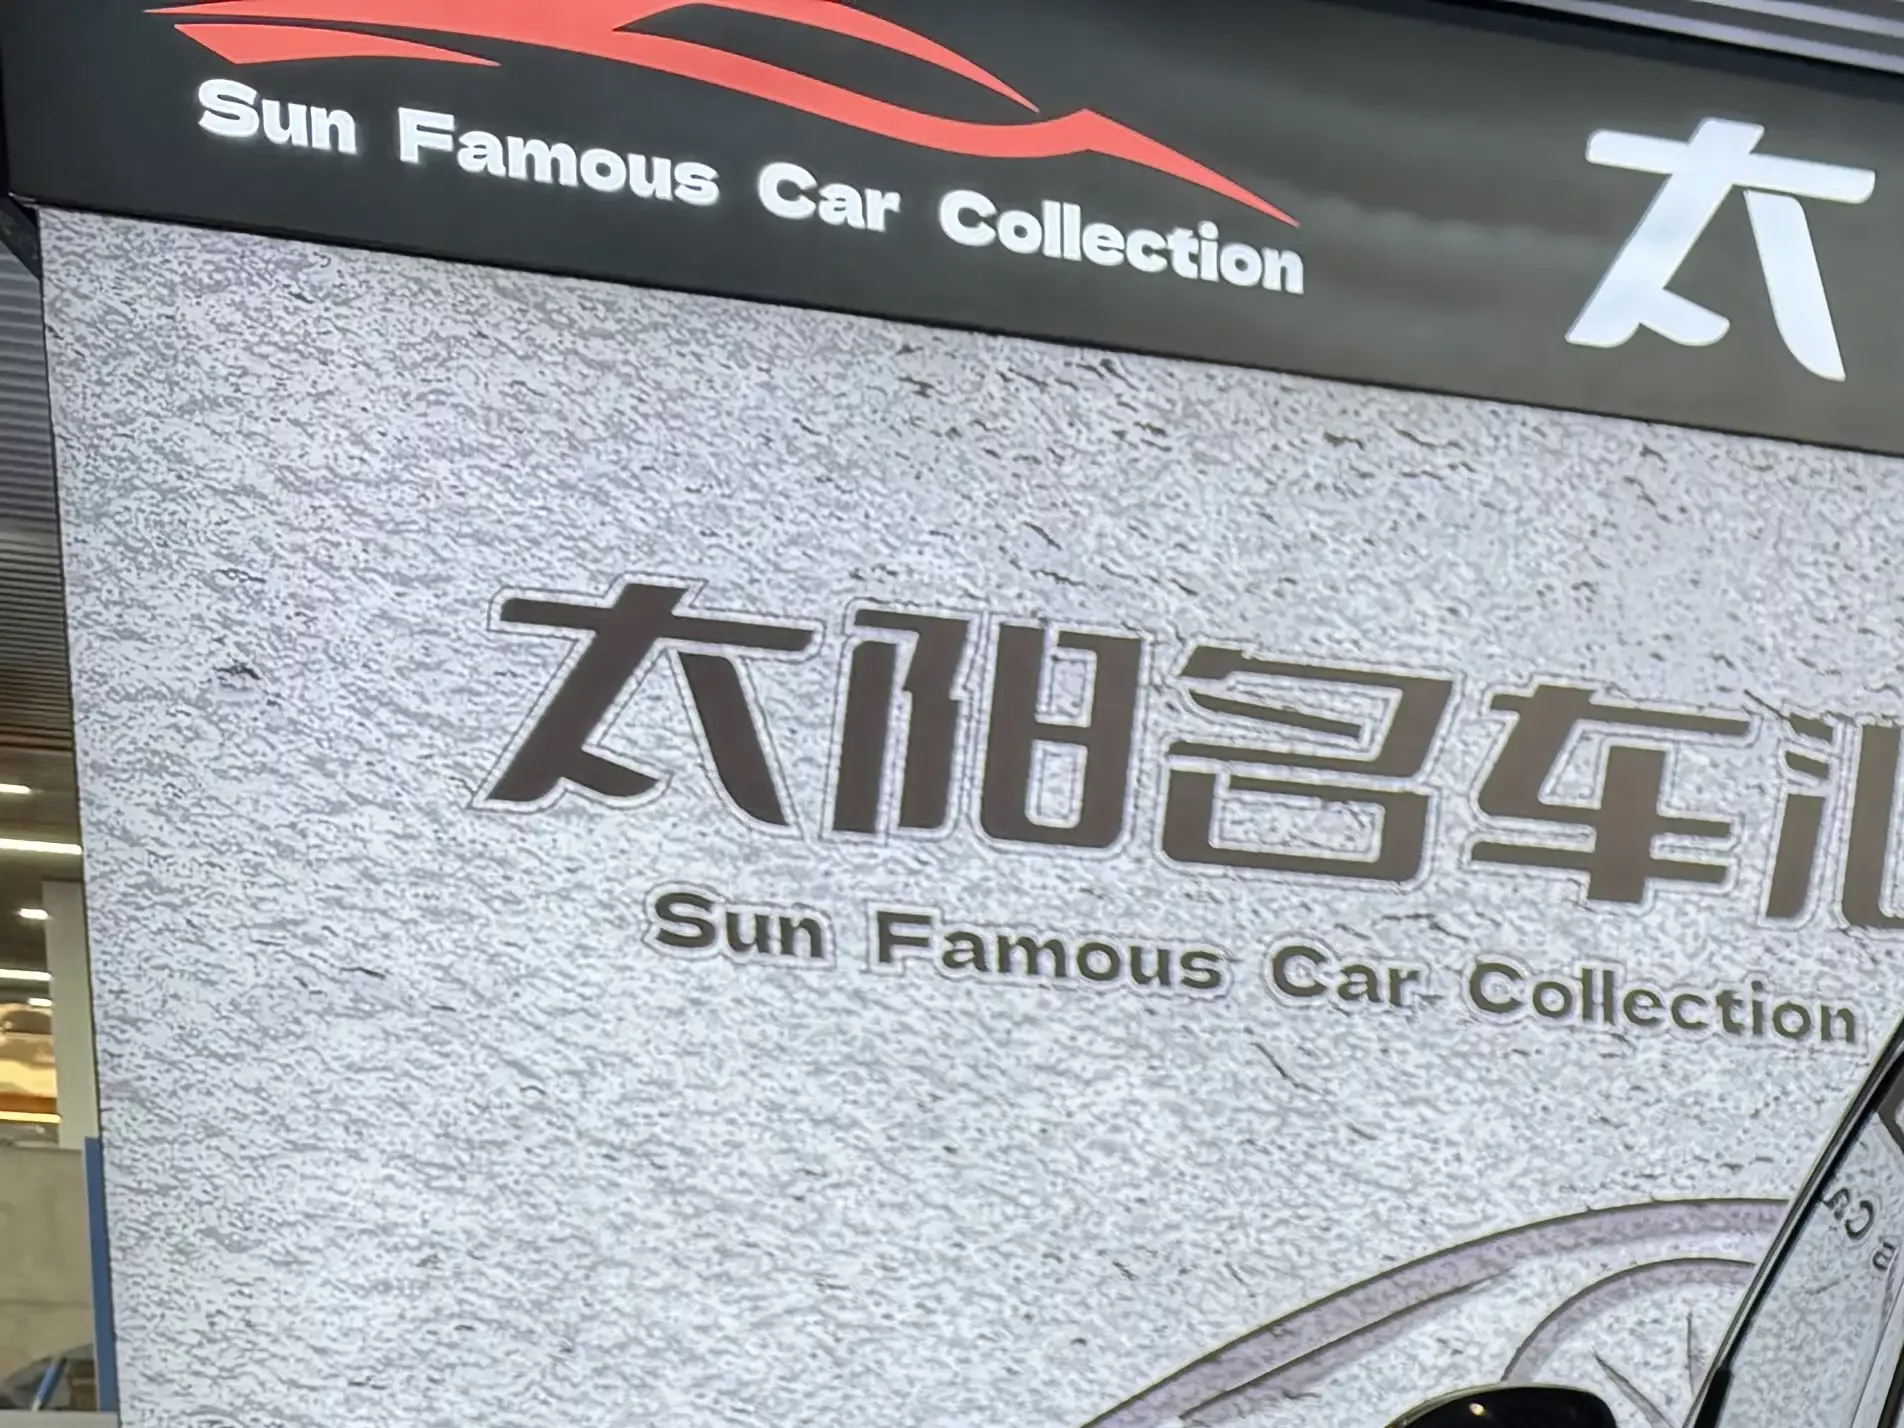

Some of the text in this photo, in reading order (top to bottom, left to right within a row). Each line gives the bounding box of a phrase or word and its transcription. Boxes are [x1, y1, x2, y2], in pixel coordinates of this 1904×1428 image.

[197, 78, 1304, 295] Sun Famous Car Collection
[655, 892, 1856, 1044] Sun Famous Car Collection
